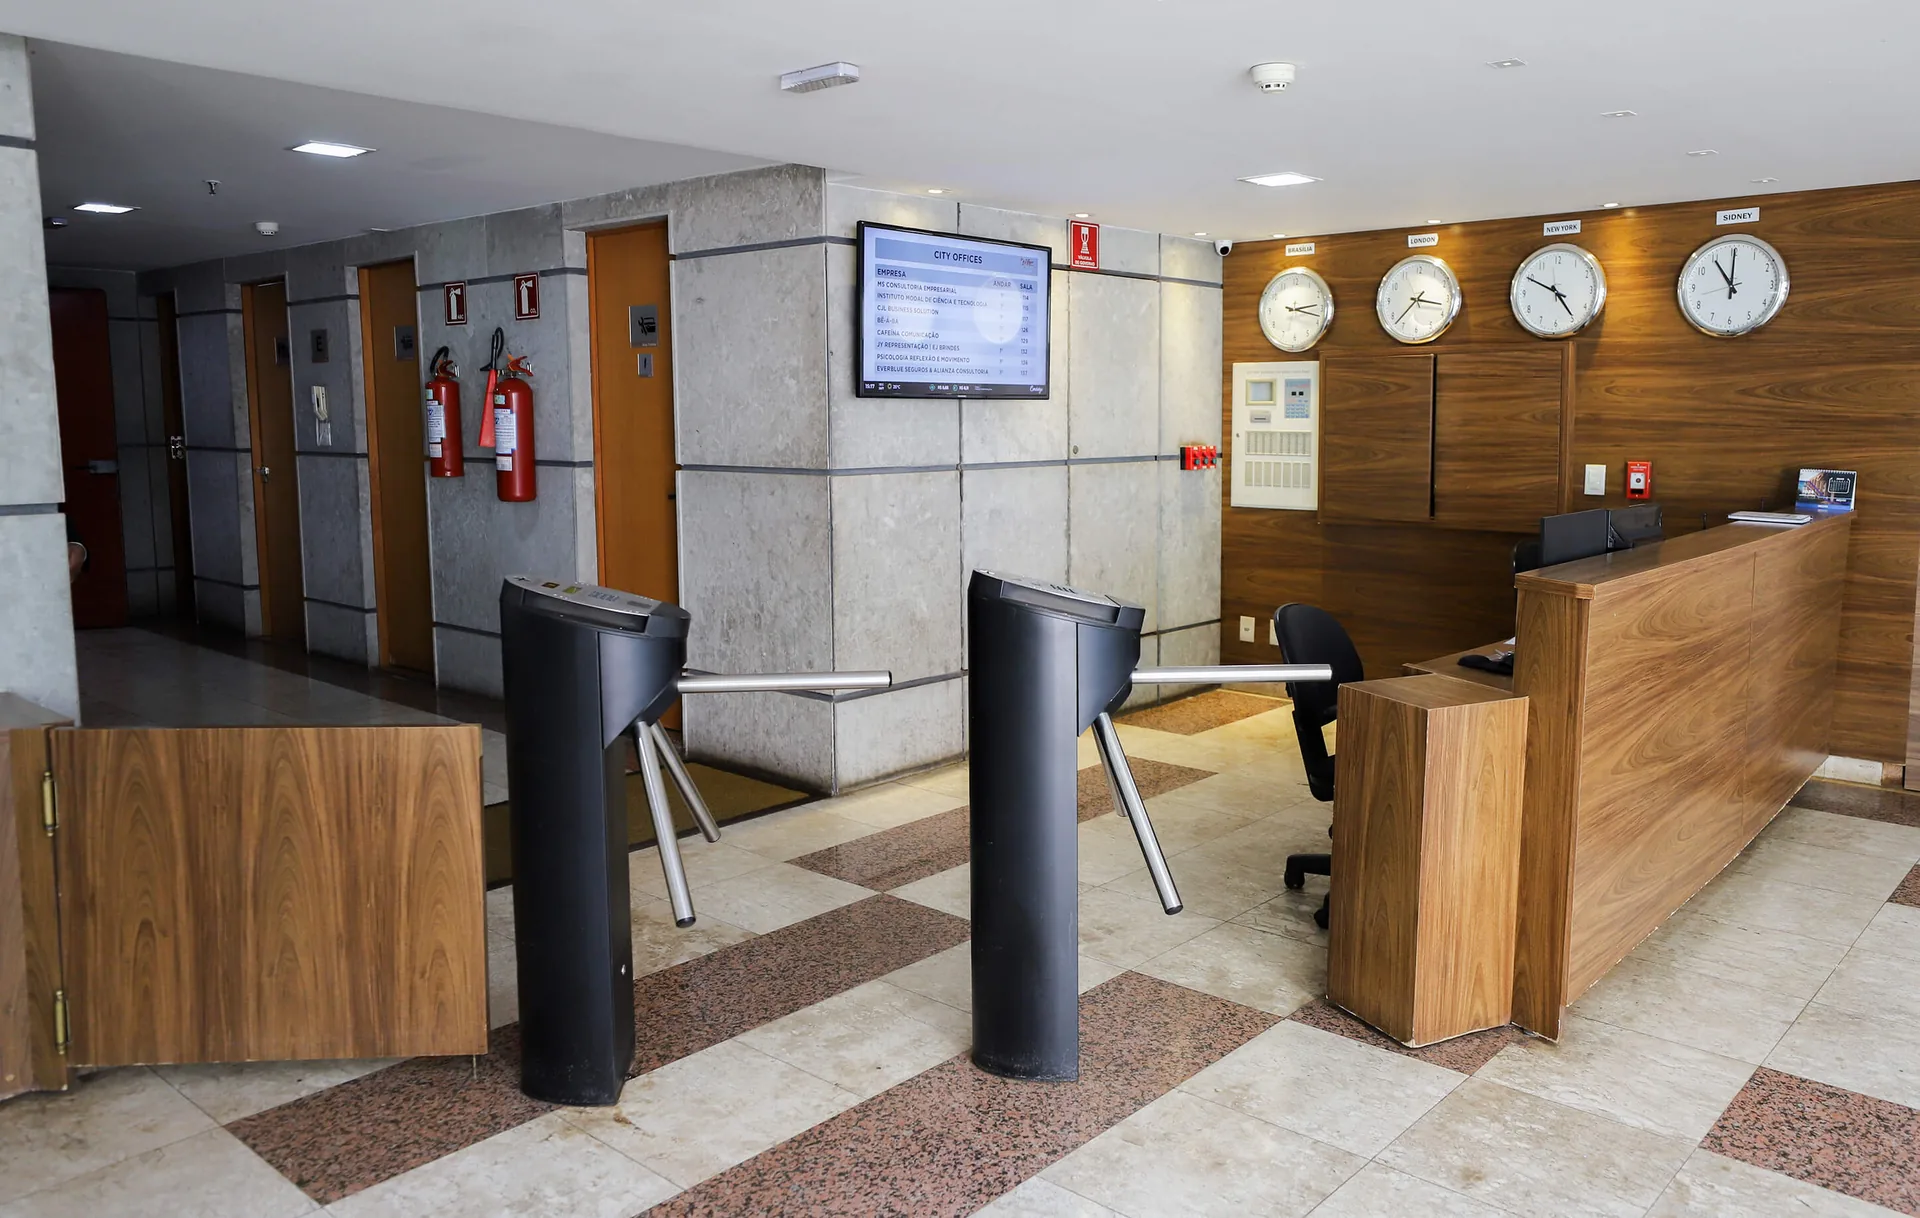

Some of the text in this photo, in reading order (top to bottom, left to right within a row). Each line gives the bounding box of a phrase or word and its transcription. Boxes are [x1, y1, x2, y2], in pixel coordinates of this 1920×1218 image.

[1723, 212, 1752, 221] SIDNEY
[1546, 223, 1578, 233] NEW YORK
[934, 250, 983, 264] CITY OFFICES
[1555, 255, 1562, 264] 12
[1711, 252, 1719, 263] 11
[1416, 266, 1422, 274] 12
[1539, 261, 1545, 270] 11
[1765, 262, 1770, 273] 2
[877, 268, 907, 278] EMPRESA
[1585, 270, 1589, 279] 2
[1697, 266, 1706, 276] 10
[886, 282, 922, 291] CONSULTORIA
[924, 286, 957, 294] EMPRESARIAL
[993, 280, 1012, 288] ANDAR
[1691, 283, 1696, 292] 9
[1769, 280, 1774, 290] 3
[1522, 289, 1526, 297] 9
[1589, 286, 1593, 295] 3
[1696, 300, 1701, 310] 8
[1762, 298, 1767, 307] 4
[913, 307, 939, 315] SOLUTION
[1527, 305, 1531, 314] 8
[1539, 315, 1543, 324] 7
[1710, 312, 1715, 321] 7
[1747, 310, 1752, 320] 5
[1553, 319, 1558, 328] 6
[1727, 315, 1732, 325] 6
[316, 335, 323, 352] E
[884, 341, 929, 350] REPRESENTAÇÃO
[877, 353, 908, 361] PSICOLOGIA
[877, 365, 904, 373] EVERBLUE
